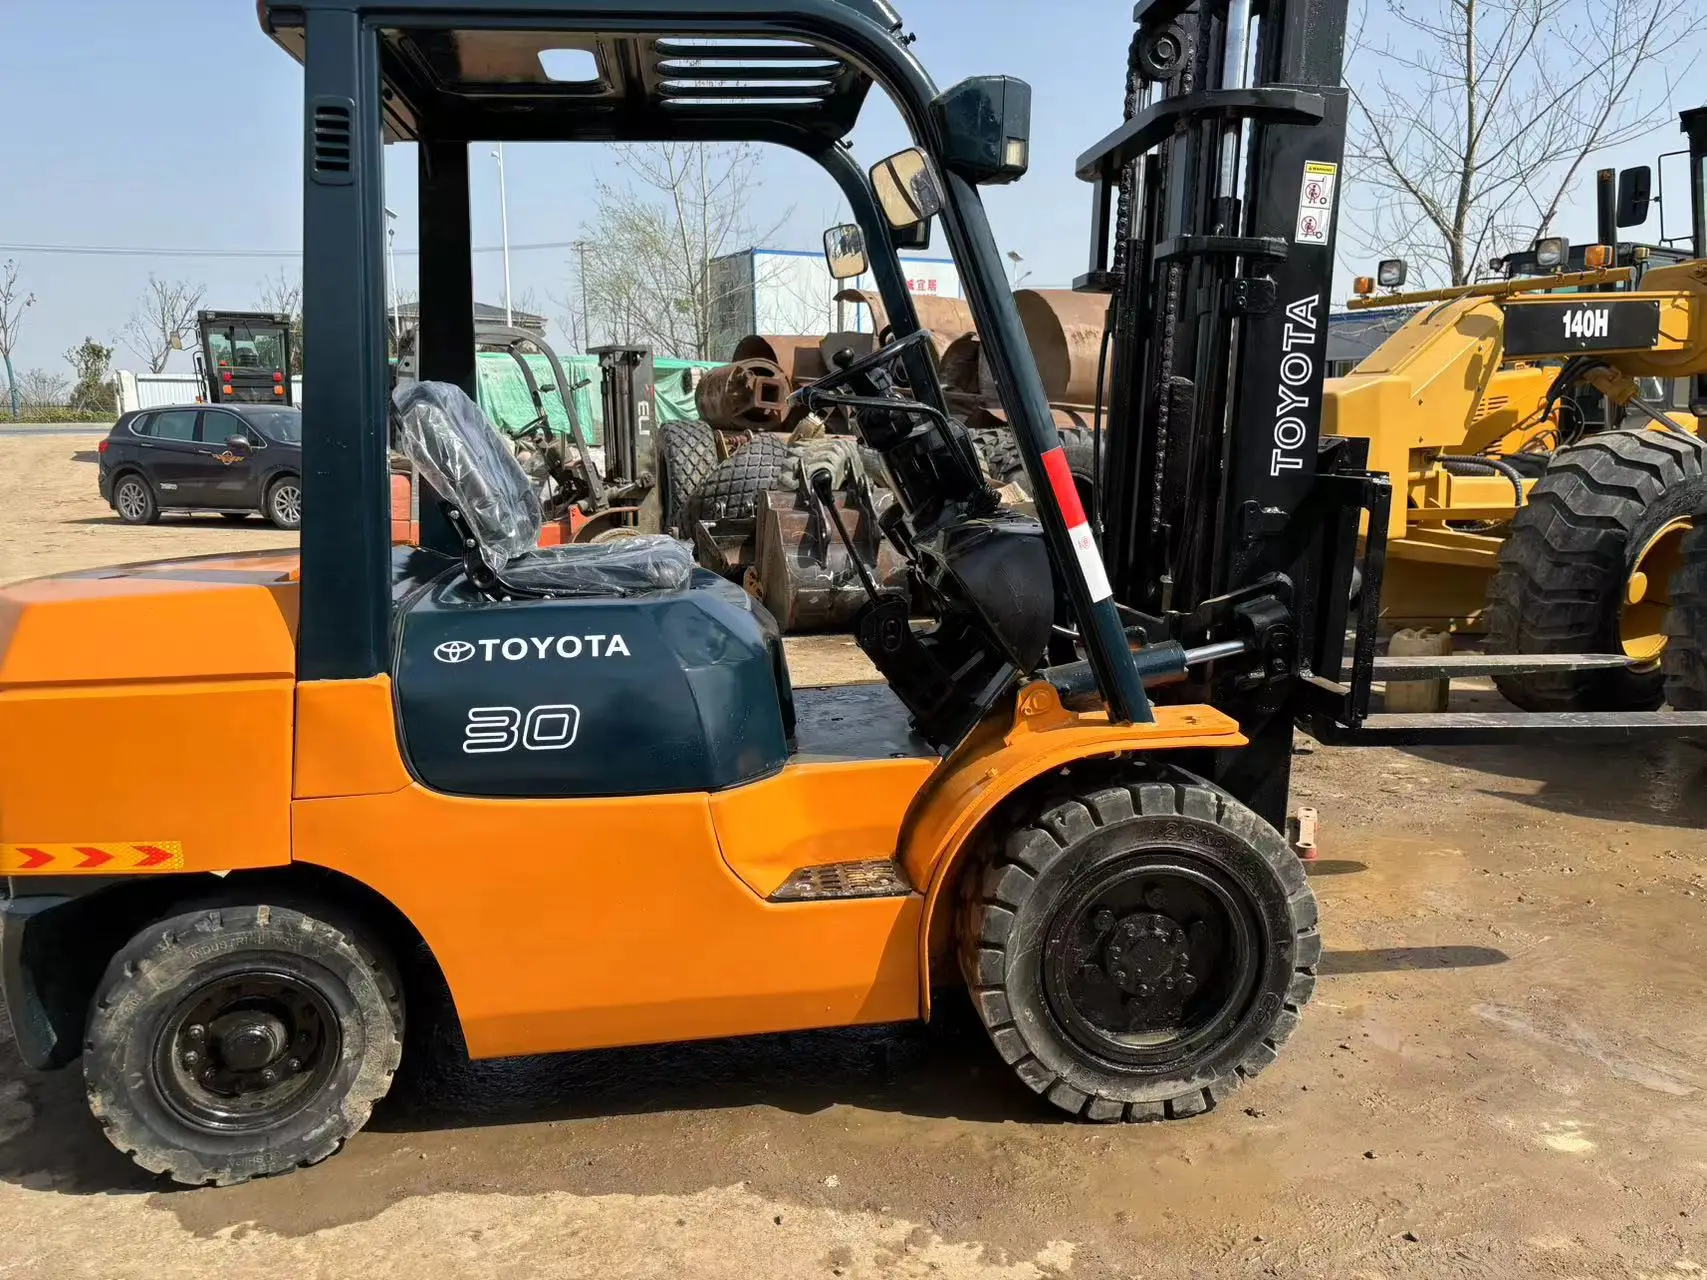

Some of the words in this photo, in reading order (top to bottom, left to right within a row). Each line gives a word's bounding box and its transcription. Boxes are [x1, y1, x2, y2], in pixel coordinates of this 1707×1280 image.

[1562, 309, 1609, 338] 140H
[1270, 294, 1320, 477] TOYOTA
[478, 634, 631, 662] TOYOTA
[462, 704, 581, 754] 30
